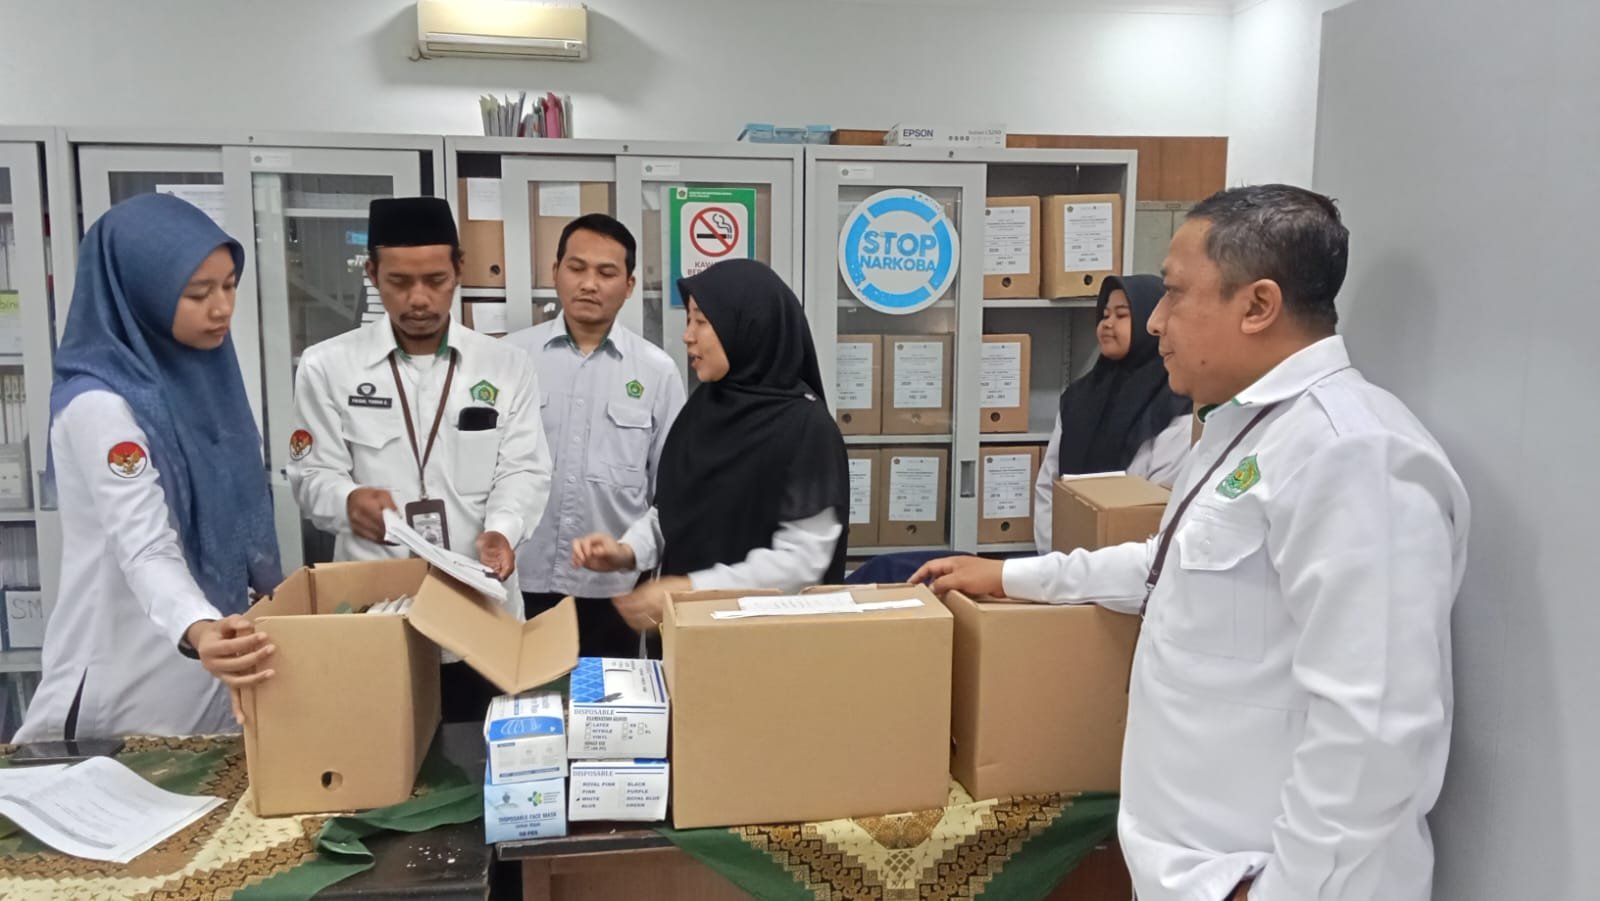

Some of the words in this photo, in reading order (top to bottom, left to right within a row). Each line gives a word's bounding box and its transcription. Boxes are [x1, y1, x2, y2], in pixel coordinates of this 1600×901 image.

[903, 129, 934, 137] EPSON
[863, 230, 937, 257] STOP
[860, 255, 937, 272] NARKOBA
